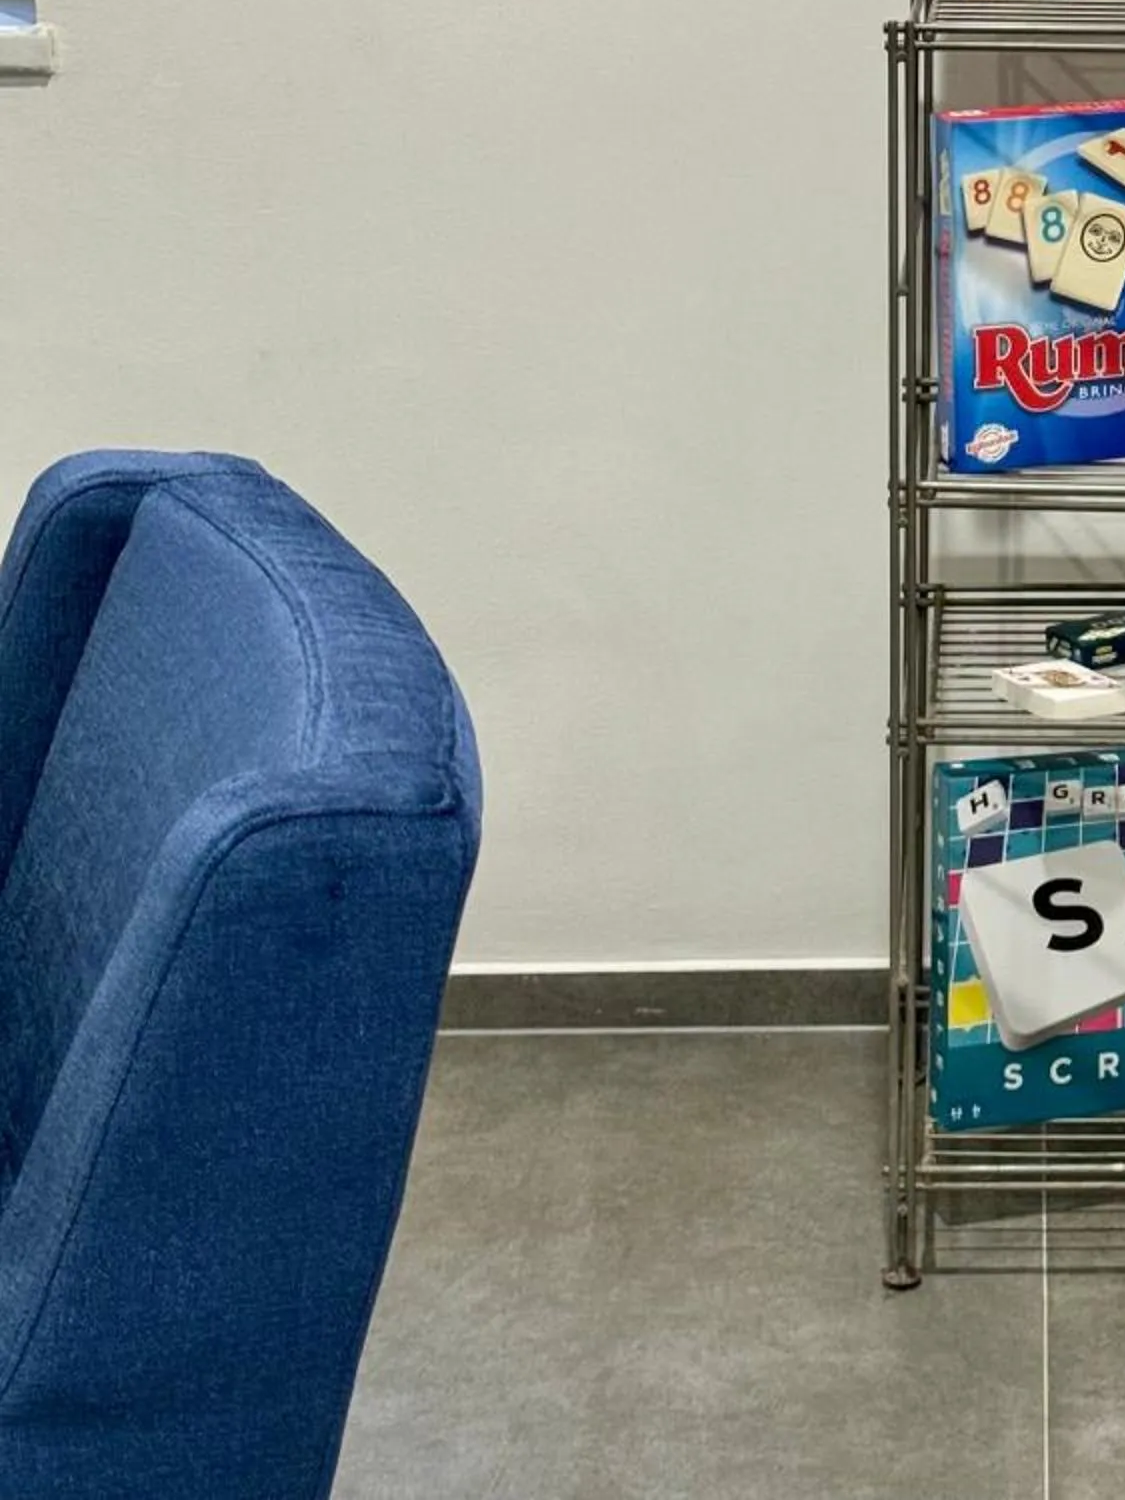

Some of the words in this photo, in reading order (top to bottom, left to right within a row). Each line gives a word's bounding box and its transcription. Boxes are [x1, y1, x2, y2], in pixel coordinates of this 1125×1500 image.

[973, 178, 992, 205] 8
[1006, 181, 1030, 212] 8
[1040, 204, 1066, 242] 8
[969, 791, 990, 815] H
[1032, 877, 1105, 953] S
